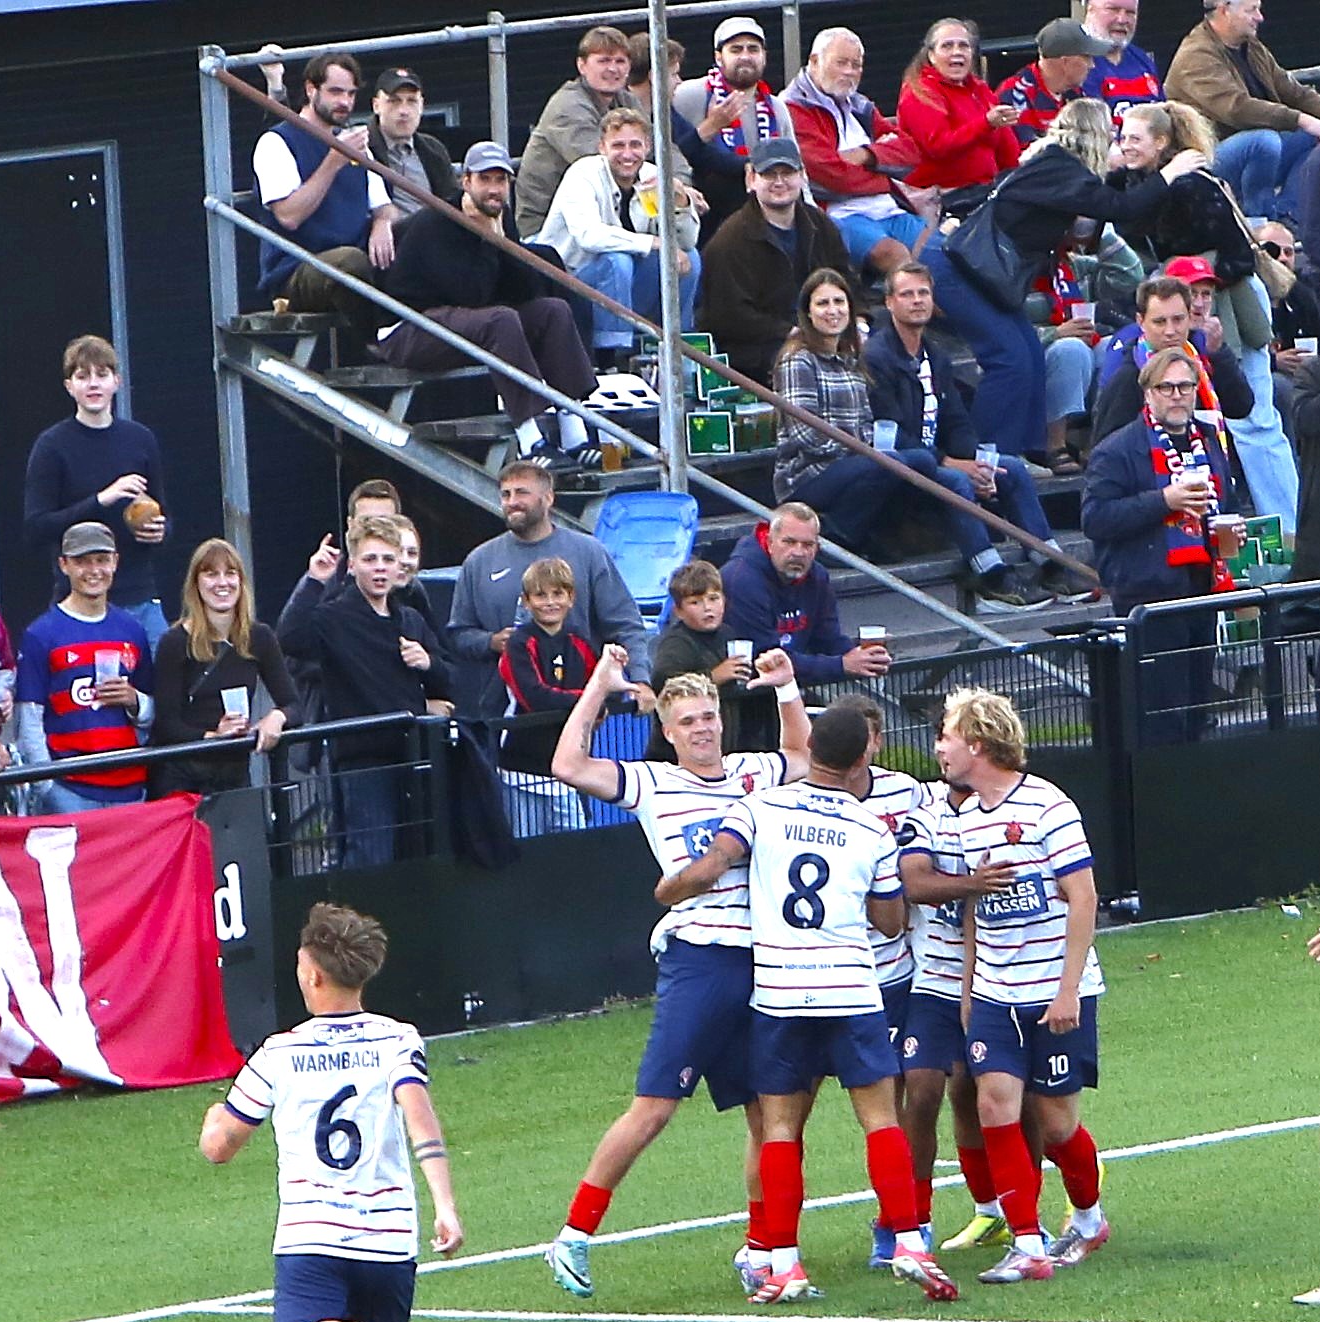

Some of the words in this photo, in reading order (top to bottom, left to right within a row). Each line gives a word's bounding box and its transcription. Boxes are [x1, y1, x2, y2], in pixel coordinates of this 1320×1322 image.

[784, 823, 847, 847] VILBERG
[782, 852, 830, 929] 8
[983, 895, 1041, 916] KASSEN
[291, 1050, 380, 1073] WARMBACH
[1048, 1054, 1069, 1075] 10
[315, 1084, 362, 1170] 6
